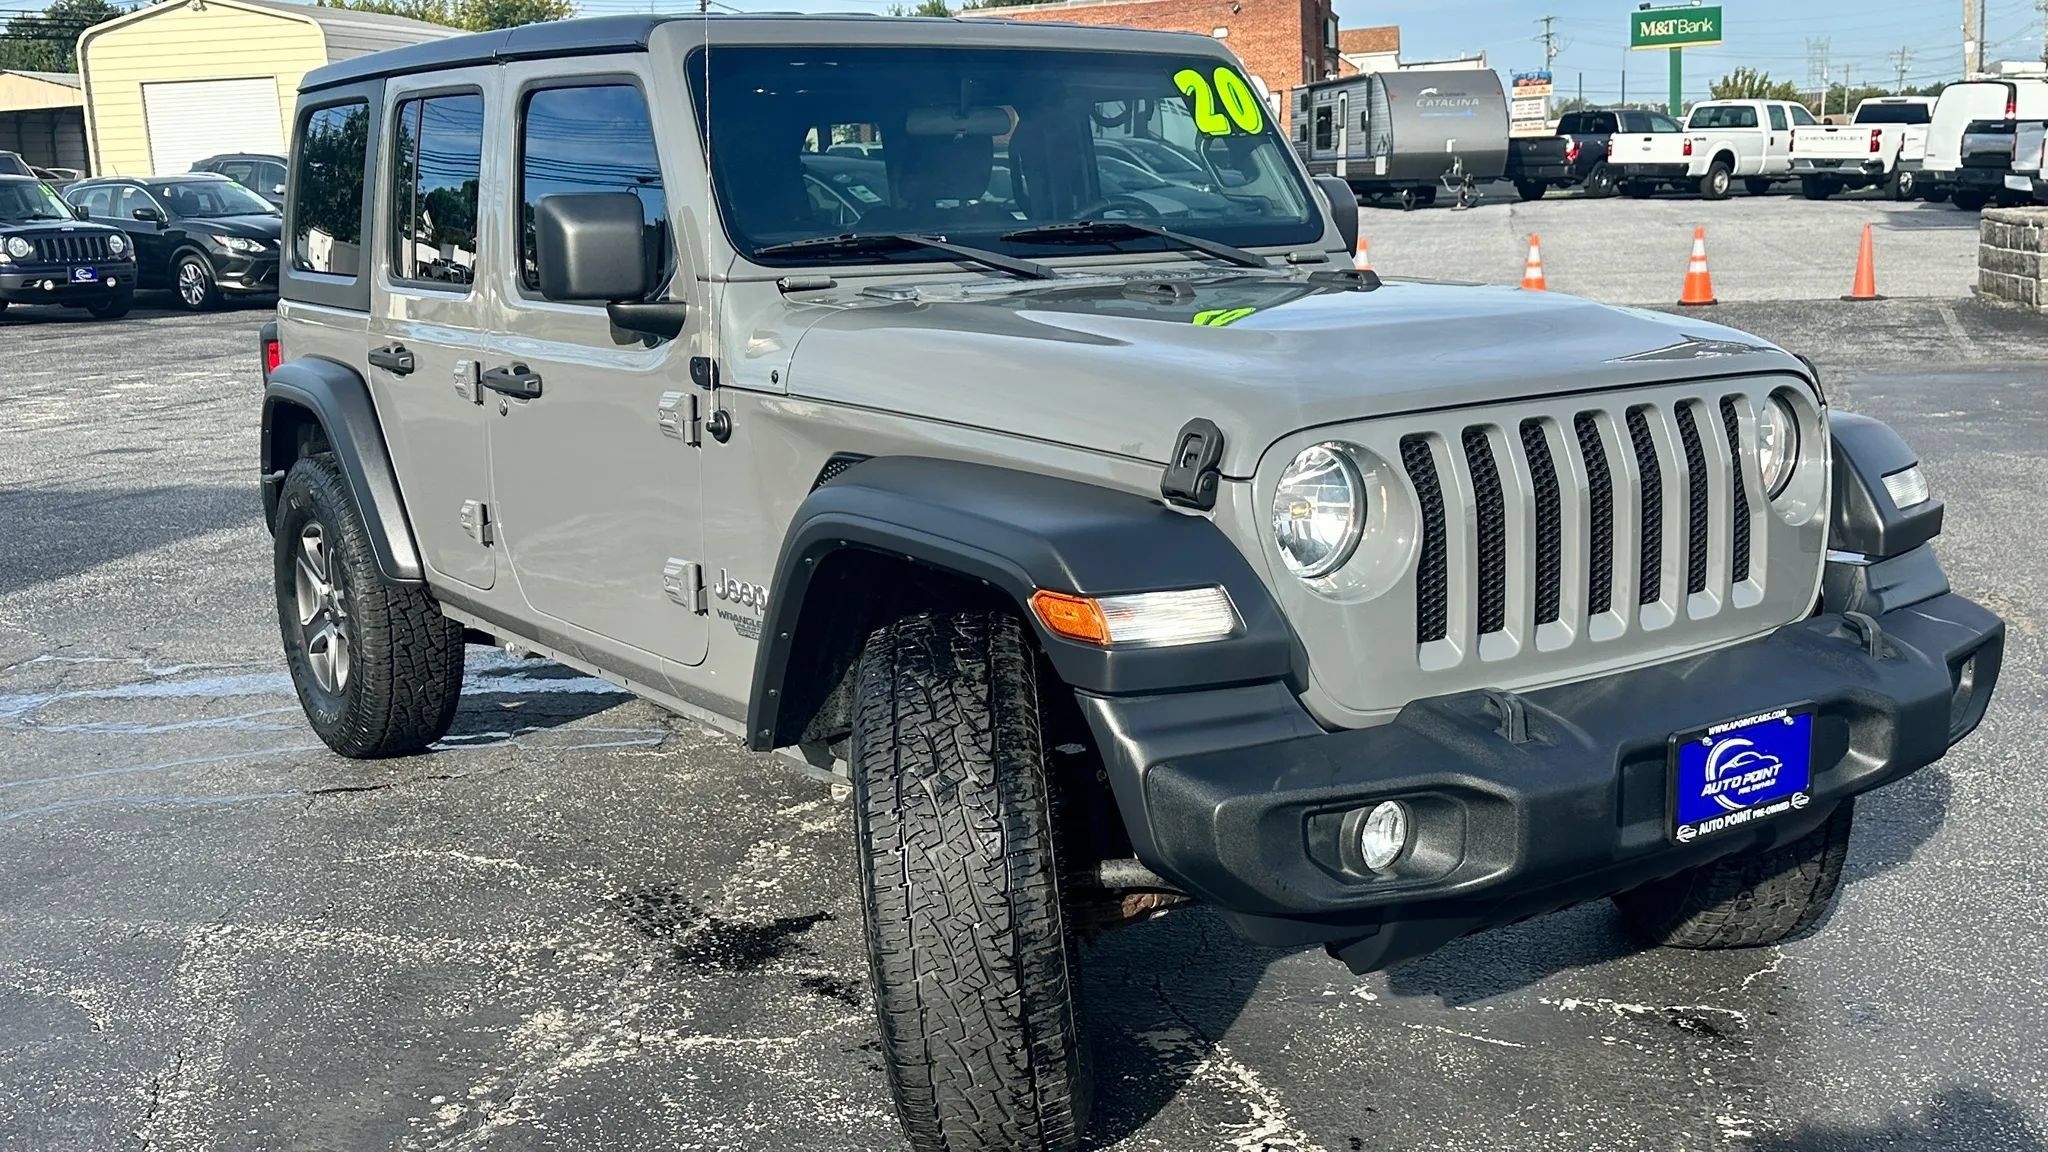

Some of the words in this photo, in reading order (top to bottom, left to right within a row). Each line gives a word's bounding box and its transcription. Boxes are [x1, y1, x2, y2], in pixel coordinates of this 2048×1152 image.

[1640, 19, 1677, 37] M&T
[1678, 17, 1714, 34] Bank
[1173, 68, 1264, 136] 20
[1416, 98, 1480, 108] CATALINA
[714, 567, 769, 616] Jeep
[717, 608, 763, 628] WRANGLE
[1701, 775, 1743, 797] AUTO
[1742, 763, 1783, 786] POINT
[1698, 818, 1724, 836] AUTO
[1724, 809, 1752, 828] POINT
[1752, 801, 1790, 819] PRE-OWNED
